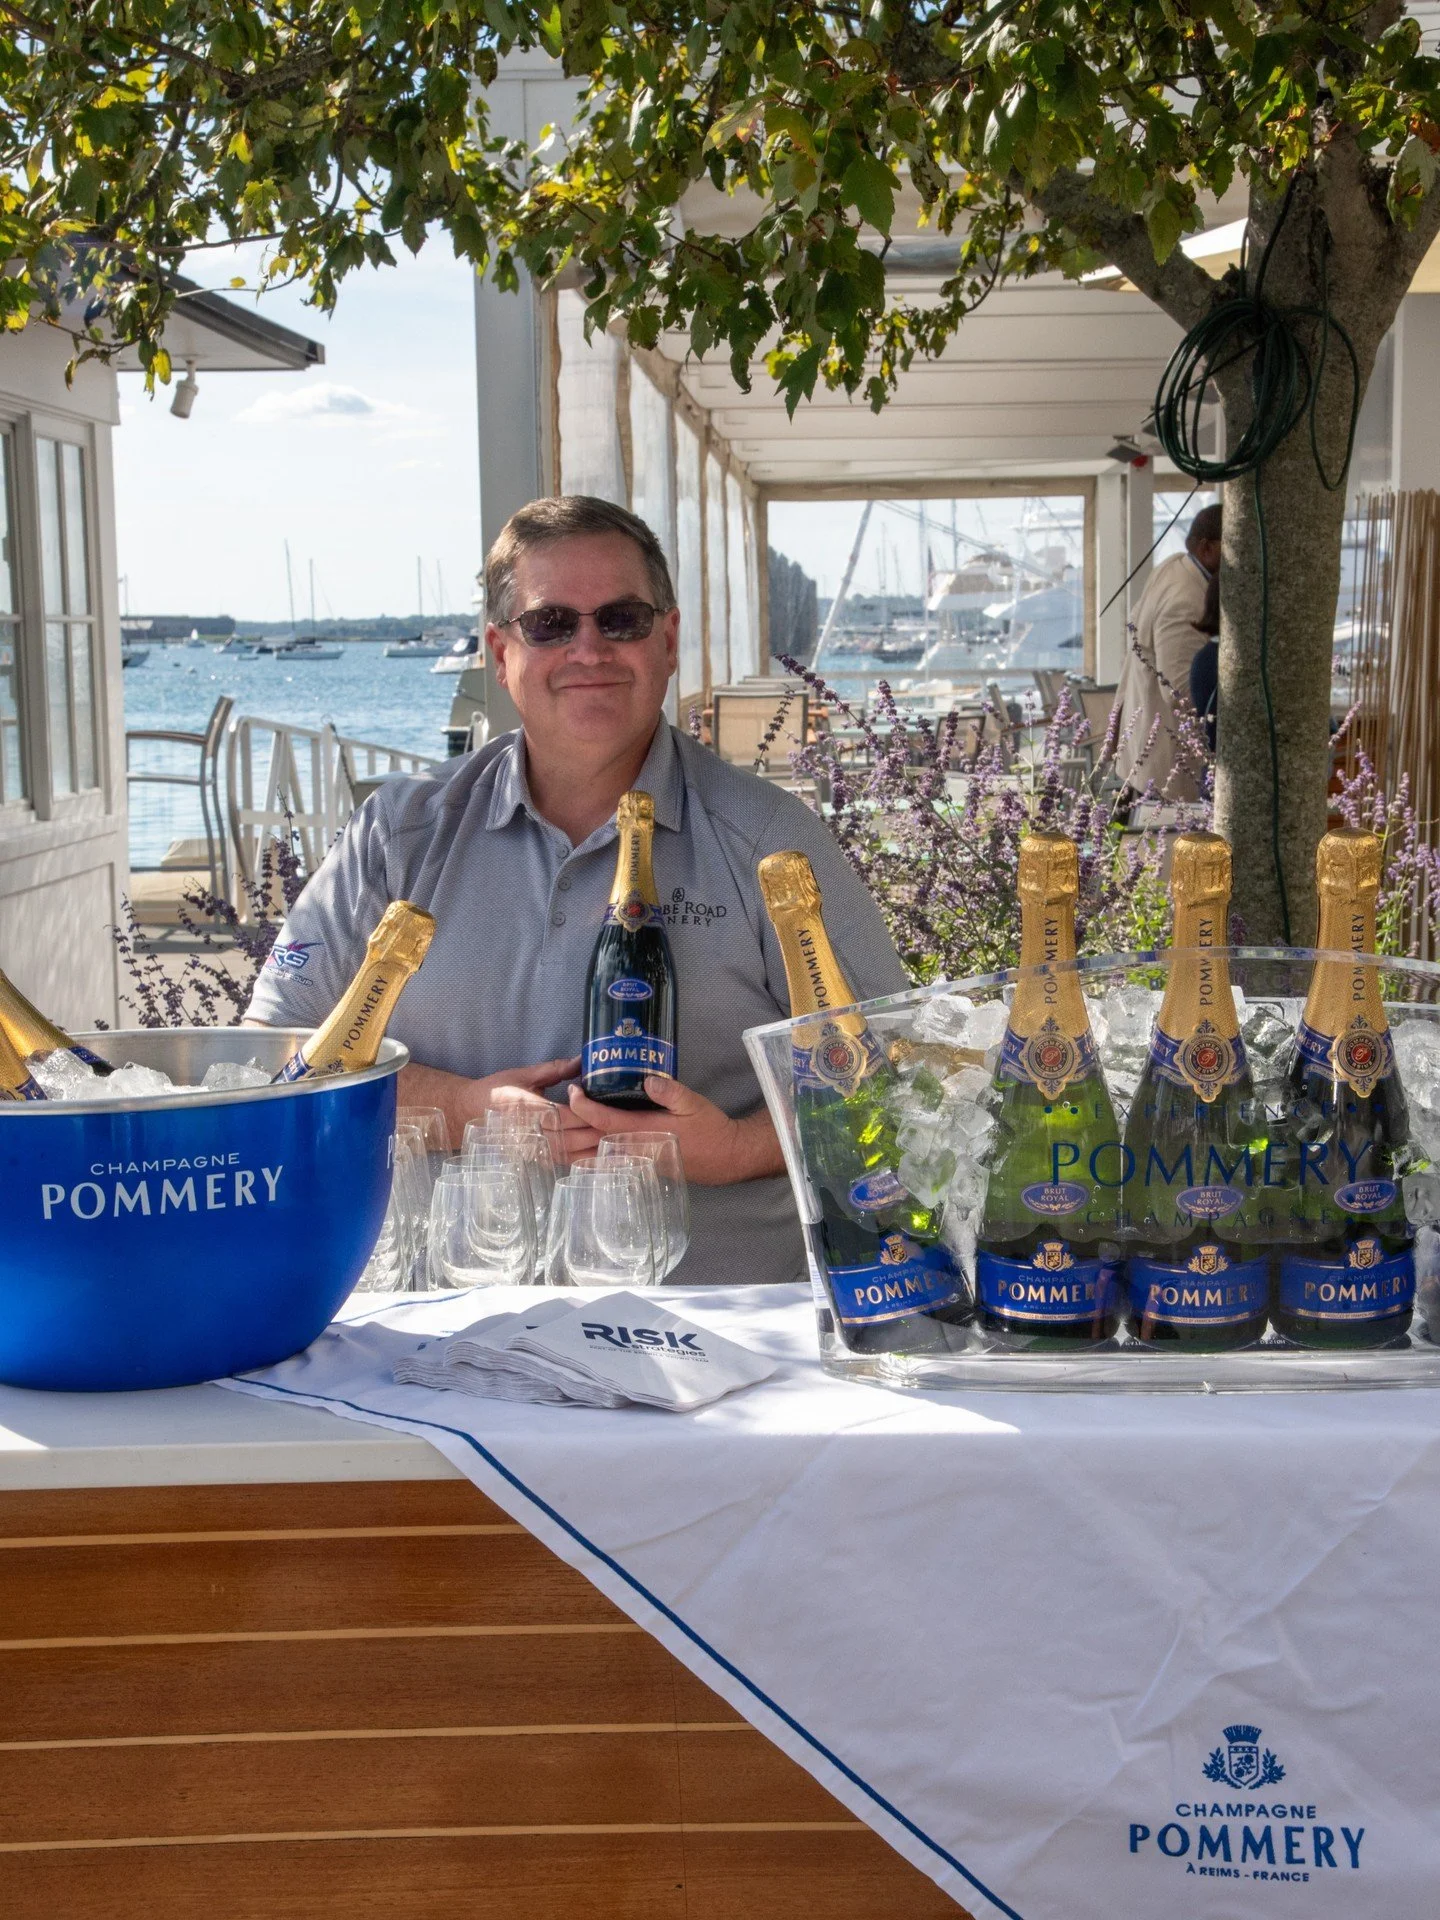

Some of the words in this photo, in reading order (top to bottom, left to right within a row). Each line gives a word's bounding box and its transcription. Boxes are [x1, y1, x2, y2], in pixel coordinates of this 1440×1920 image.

[630, 831, 640, 882] POMMERY
[685, 901, 727, 918] ROAD
[797, 928, 831, 1009] POMMERY
[342, 975, 388, 1051] POMMERY
[592, 1047, 665, 1065] POMMERY
[90, 1152, 240, 1176] CHAMPAGNE
[1052, 1140, 1374, 1188] POMMERY
[41, 1165, 283, 1220] POMMERY
[1355, 1193, 1381, 1201] ROYAL
[1359, 1184, 1380, 1193] BRUT
[1196, 1198, 1226, 1206] ROYAL
[998, 1280, 1095, 1303] POMMER
[581, 1322, 703, 1351] RISK
[631, 1344, 706, 1357] strategies
[1175, 1803, 1316, 1819] CHAMPAGNE
[1129, 1823, 1365, 1869] POMMERY
[1199, 1866, 1241, 1879] REIMS
[1252, 1870, 1310, 1882] FRANCE
